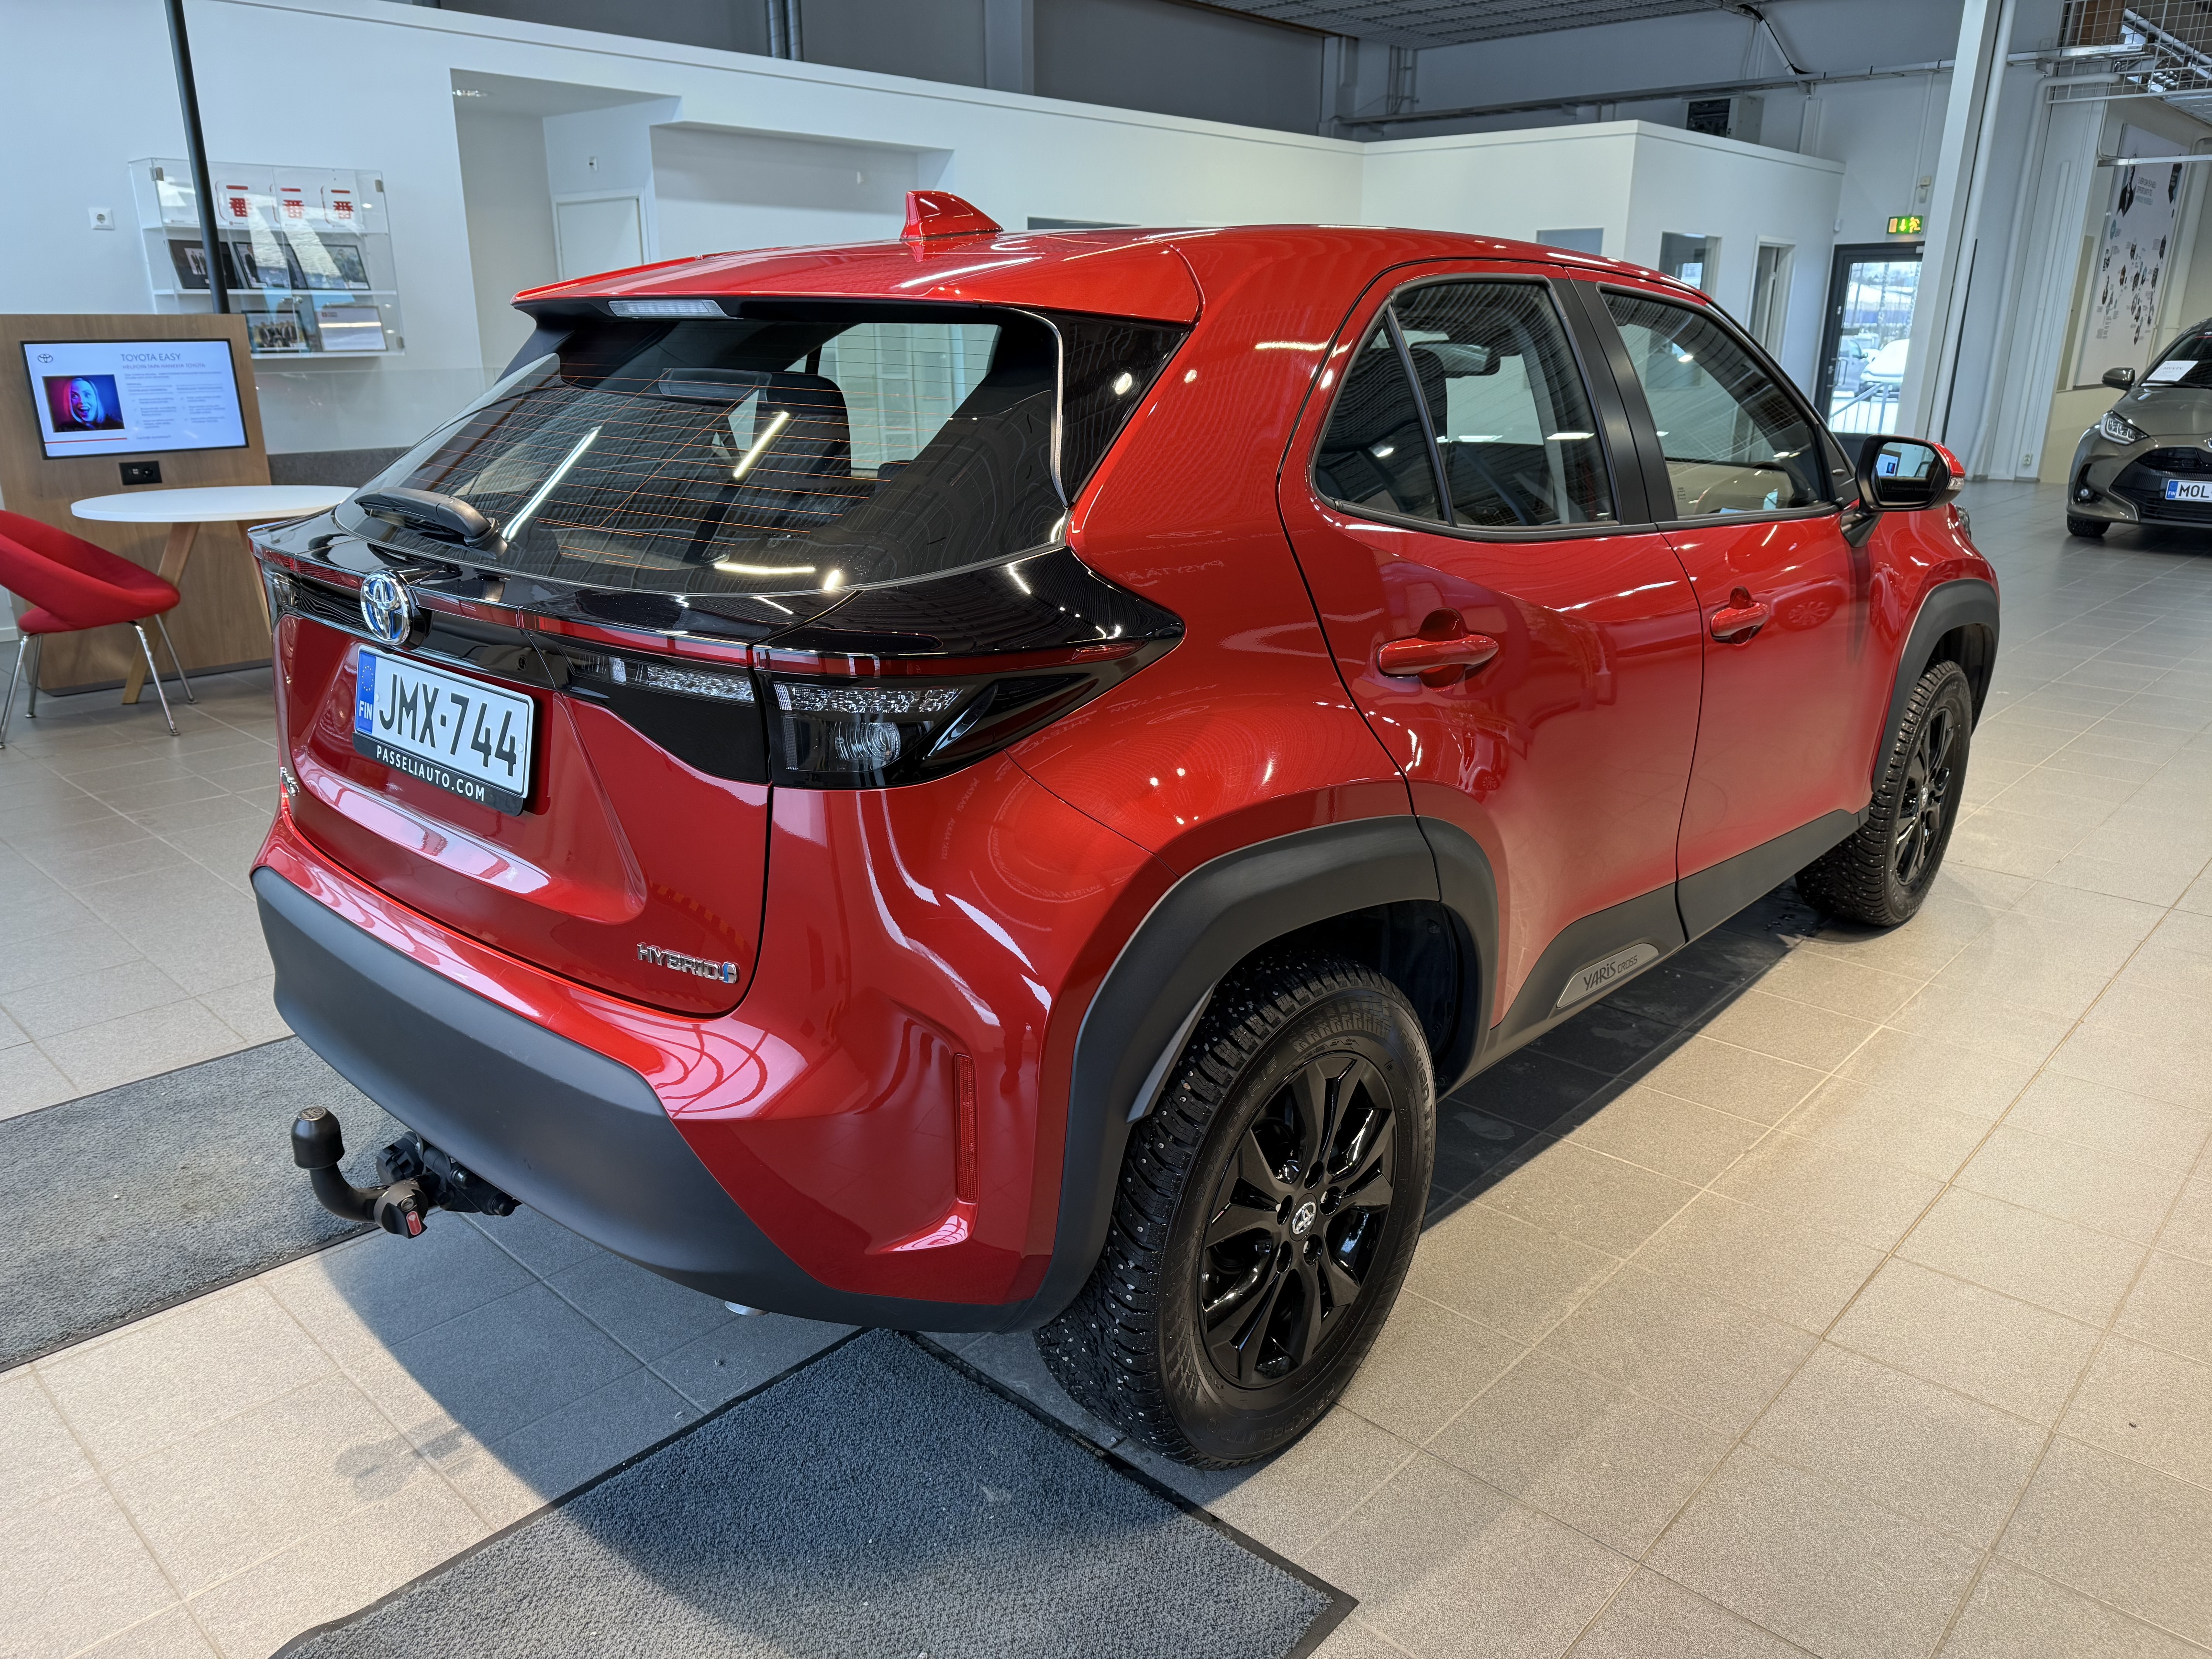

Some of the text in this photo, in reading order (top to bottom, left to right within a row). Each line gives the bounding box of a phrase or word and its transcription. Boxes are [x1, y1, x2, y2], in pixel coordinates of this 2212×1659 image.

[120, 354, 156, 362] TOYOTA
[359, 673, 517, 777] FIN JMX-744
[376, 745, 485, 802] PASSELIAUTO.COM
[637, 942, 721, 981] HYBRID
[1618, 955, 1637, 974] CROSS
